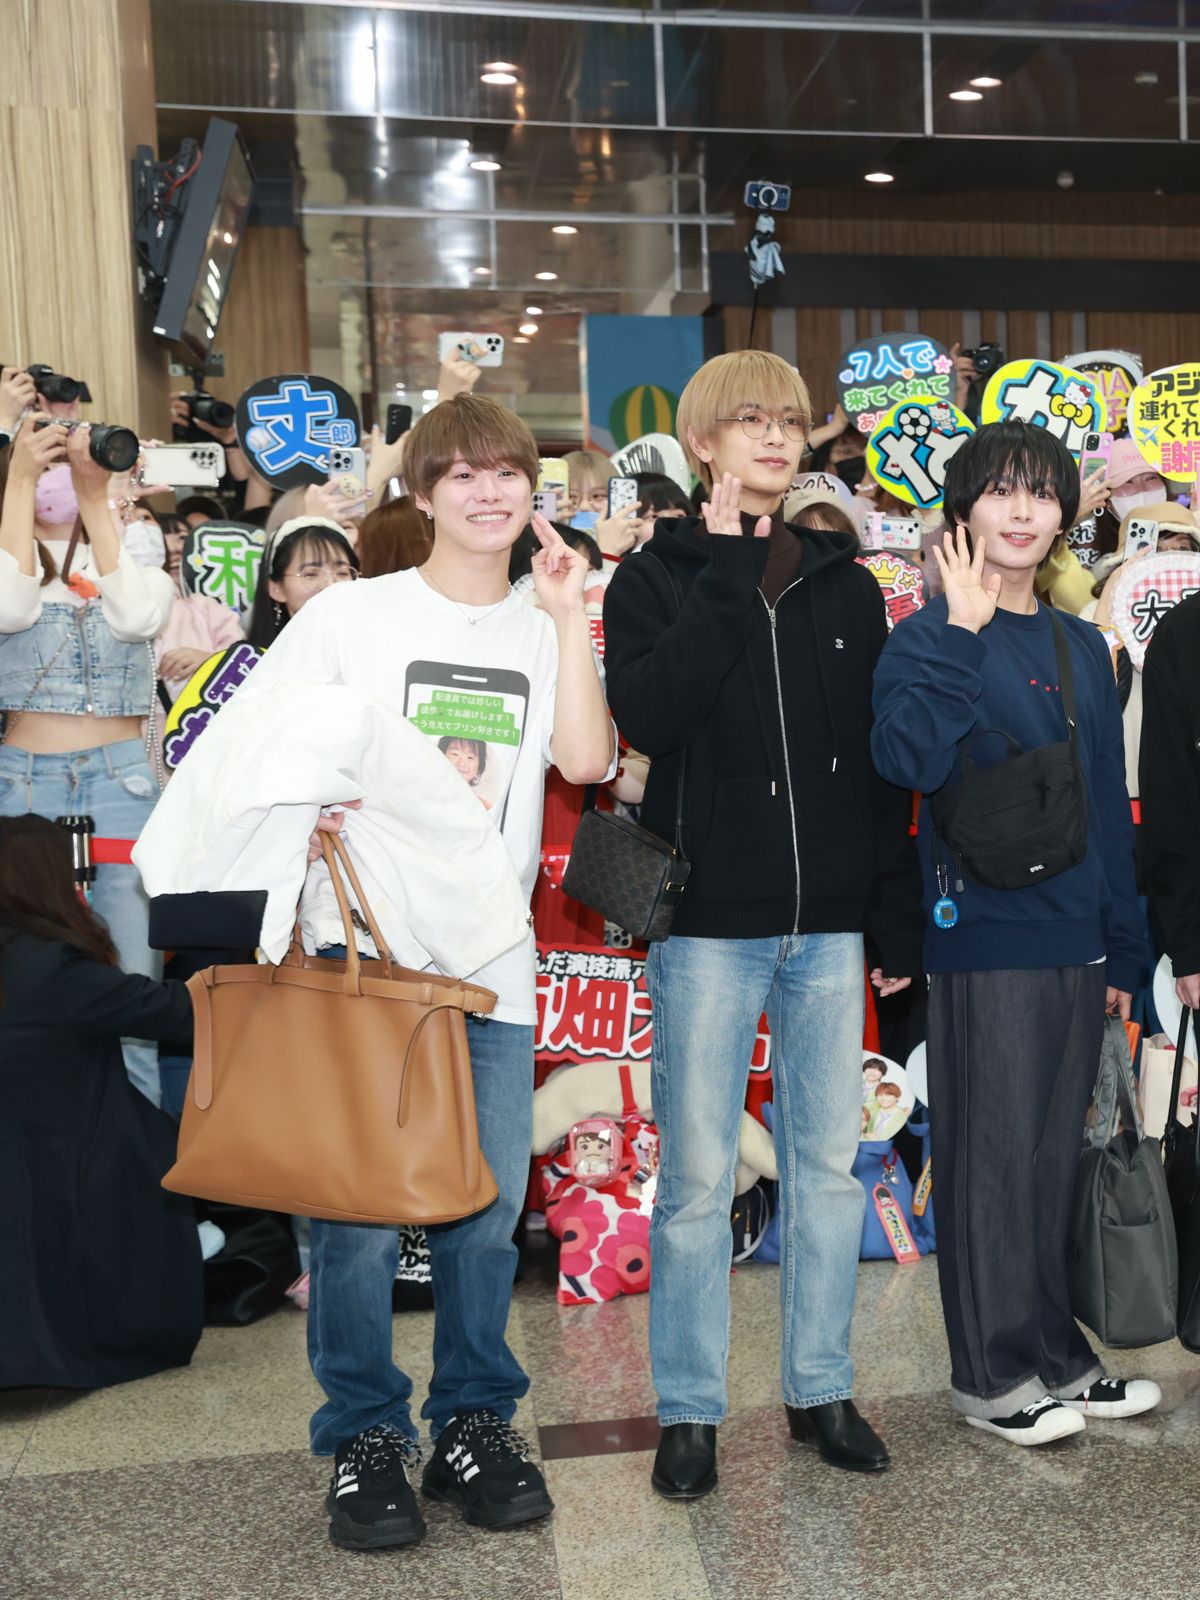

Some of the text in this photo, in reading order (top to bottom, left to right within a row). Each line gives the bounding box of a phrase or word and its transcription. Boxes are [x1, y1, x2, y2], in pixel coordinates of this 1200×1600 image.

[850, 341, 937, 381] 7人で
[844, 375, 950, 412] 来てくれて
